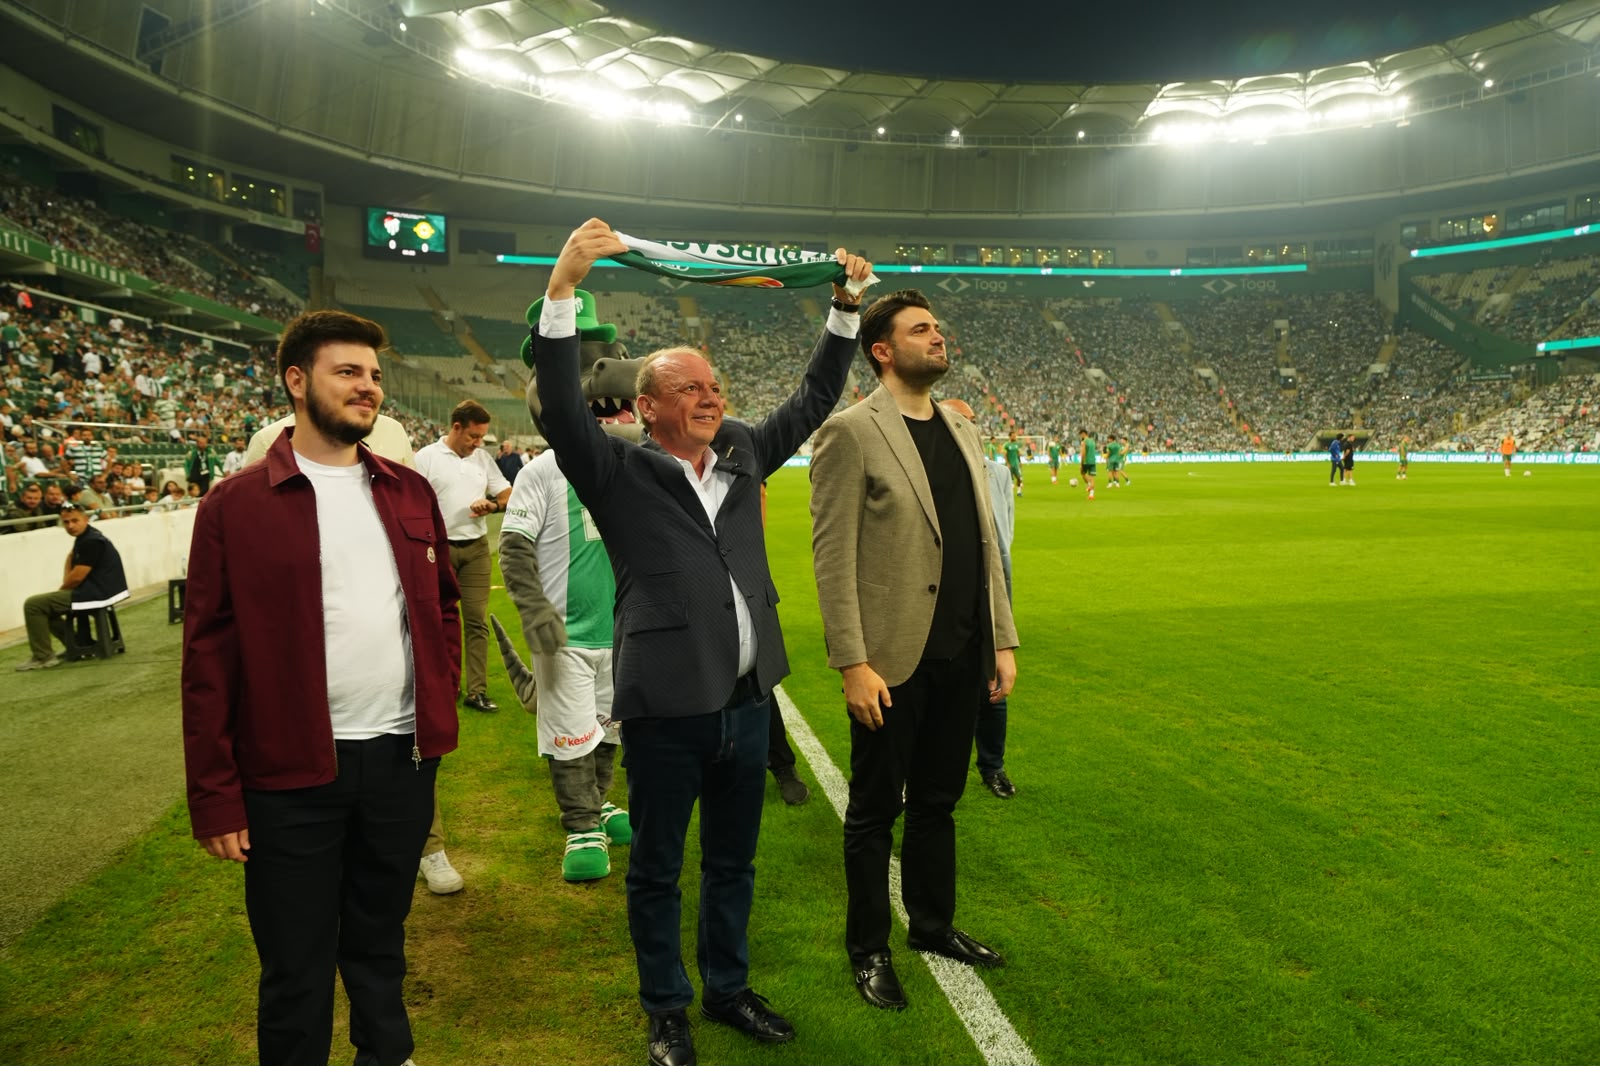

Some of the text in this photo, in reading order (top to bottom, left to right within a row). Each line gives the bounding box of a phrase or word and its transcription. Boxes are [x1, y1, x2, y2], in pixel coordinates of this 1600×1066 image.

[0, 231, 29, 254] TLI
[972, 277, 1008, 293] Togg
[1240, 278, 1276, 292] Togg
[1575, 453, 1599, 463] ÖZER
